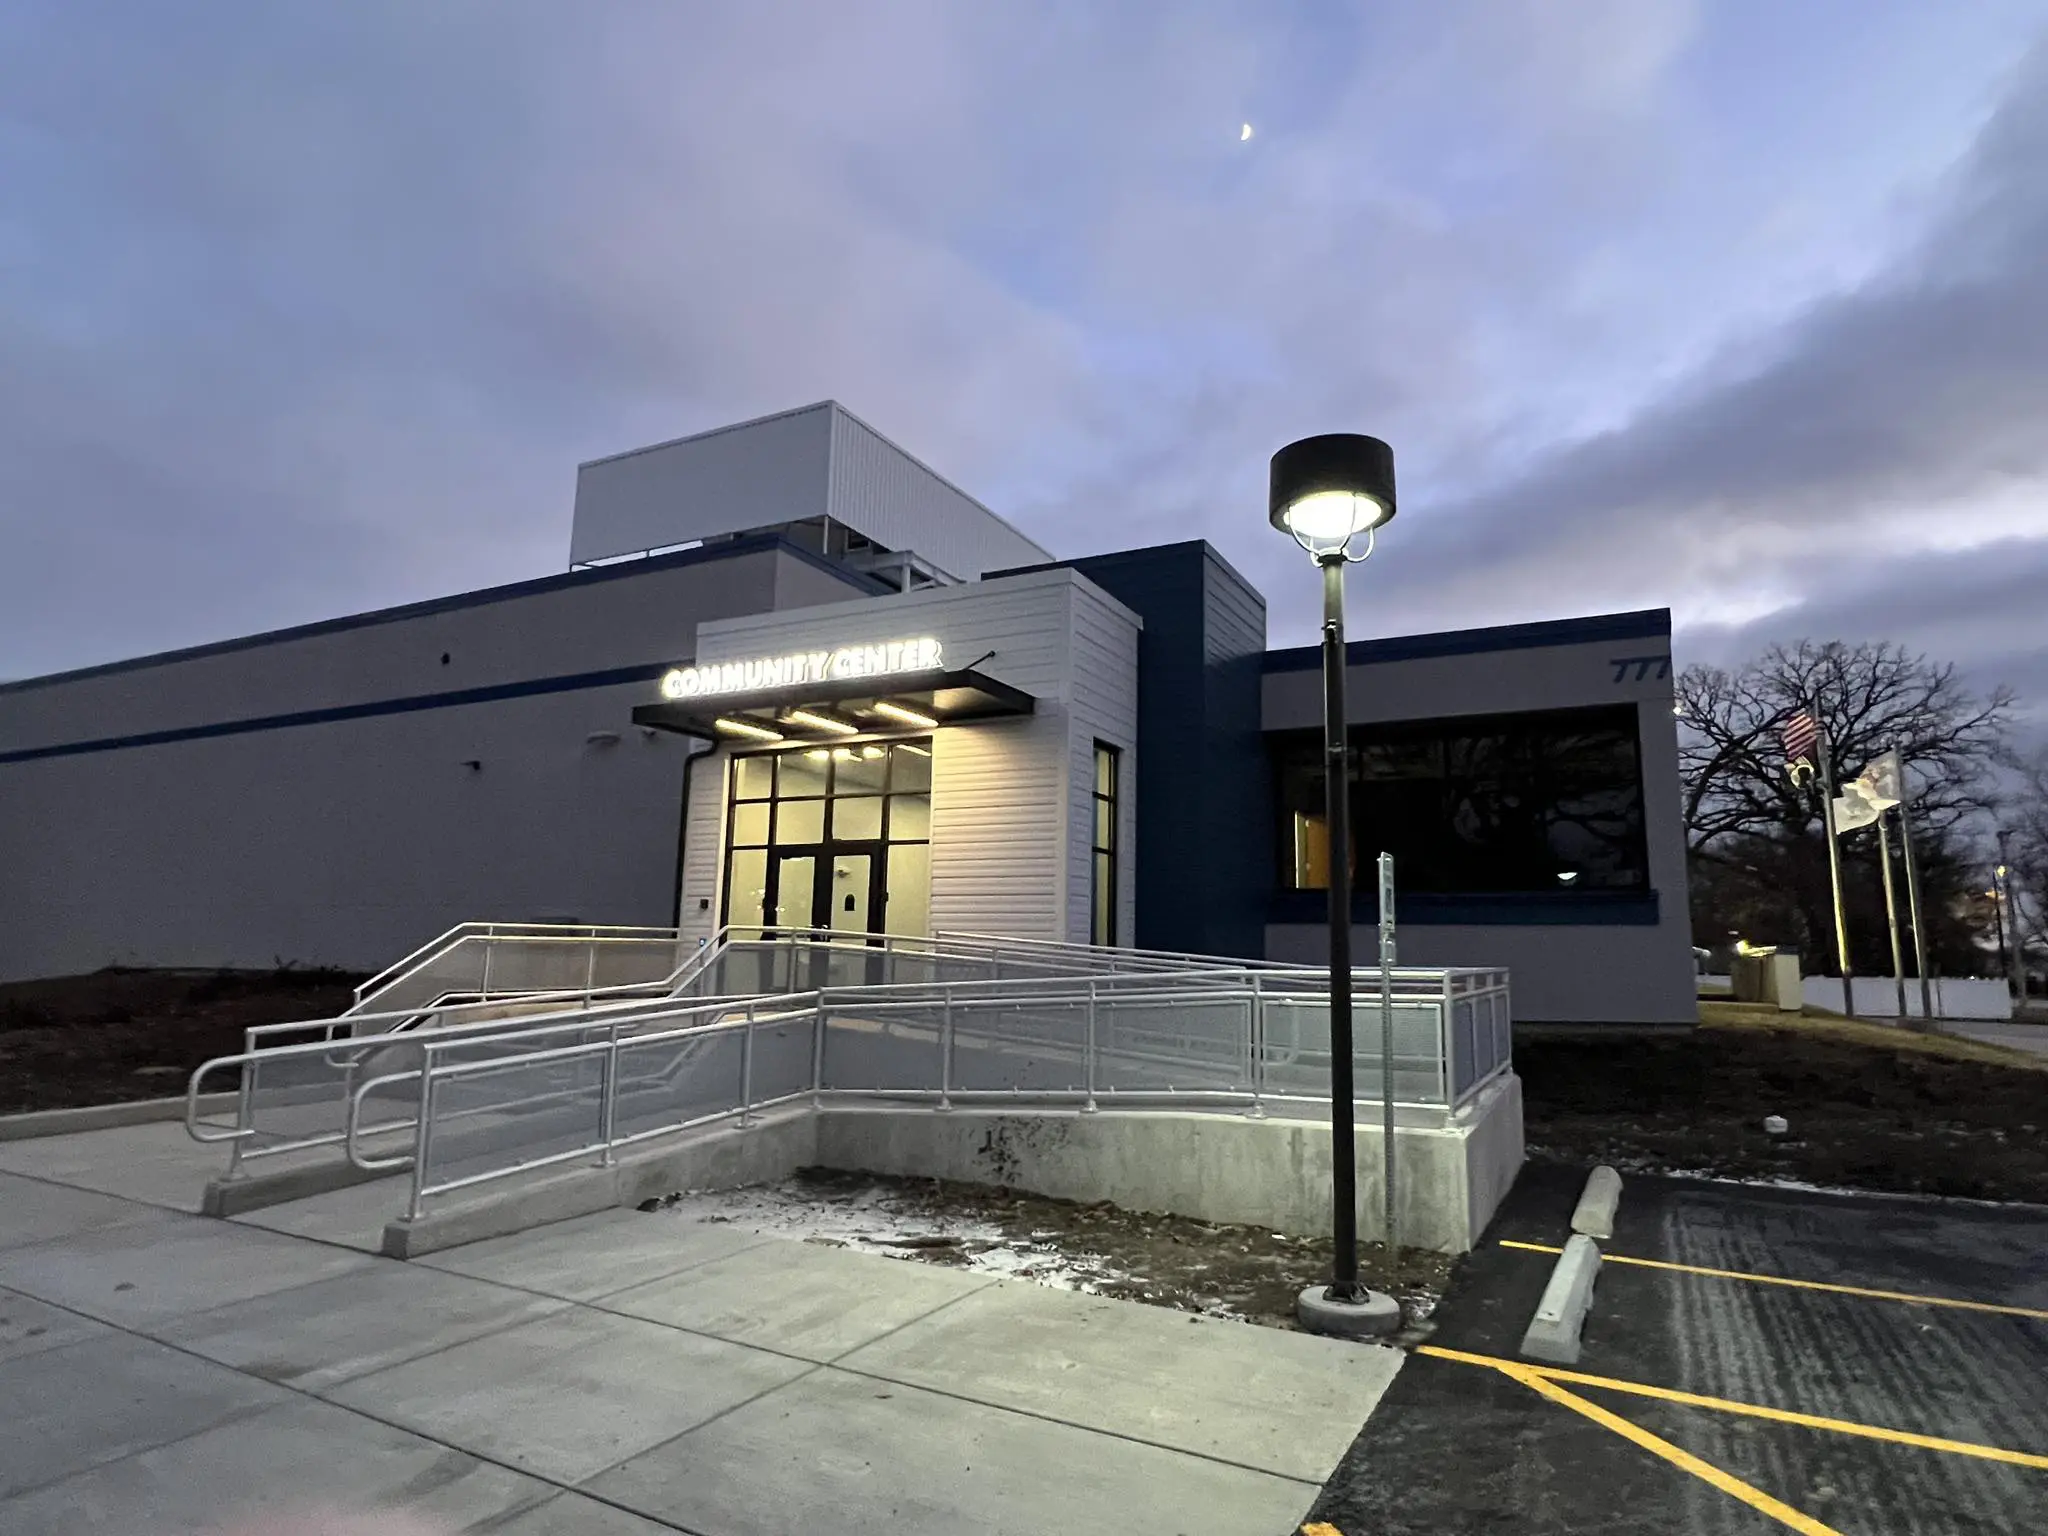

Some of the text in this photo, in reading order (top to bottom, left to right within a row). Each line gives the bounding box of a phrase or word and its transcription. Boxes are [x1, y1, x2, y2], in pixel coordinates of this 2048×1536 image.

[662, 639, 943, 698] COMMUNITY CENTER
[1610, 655, 1671, 683] 777
